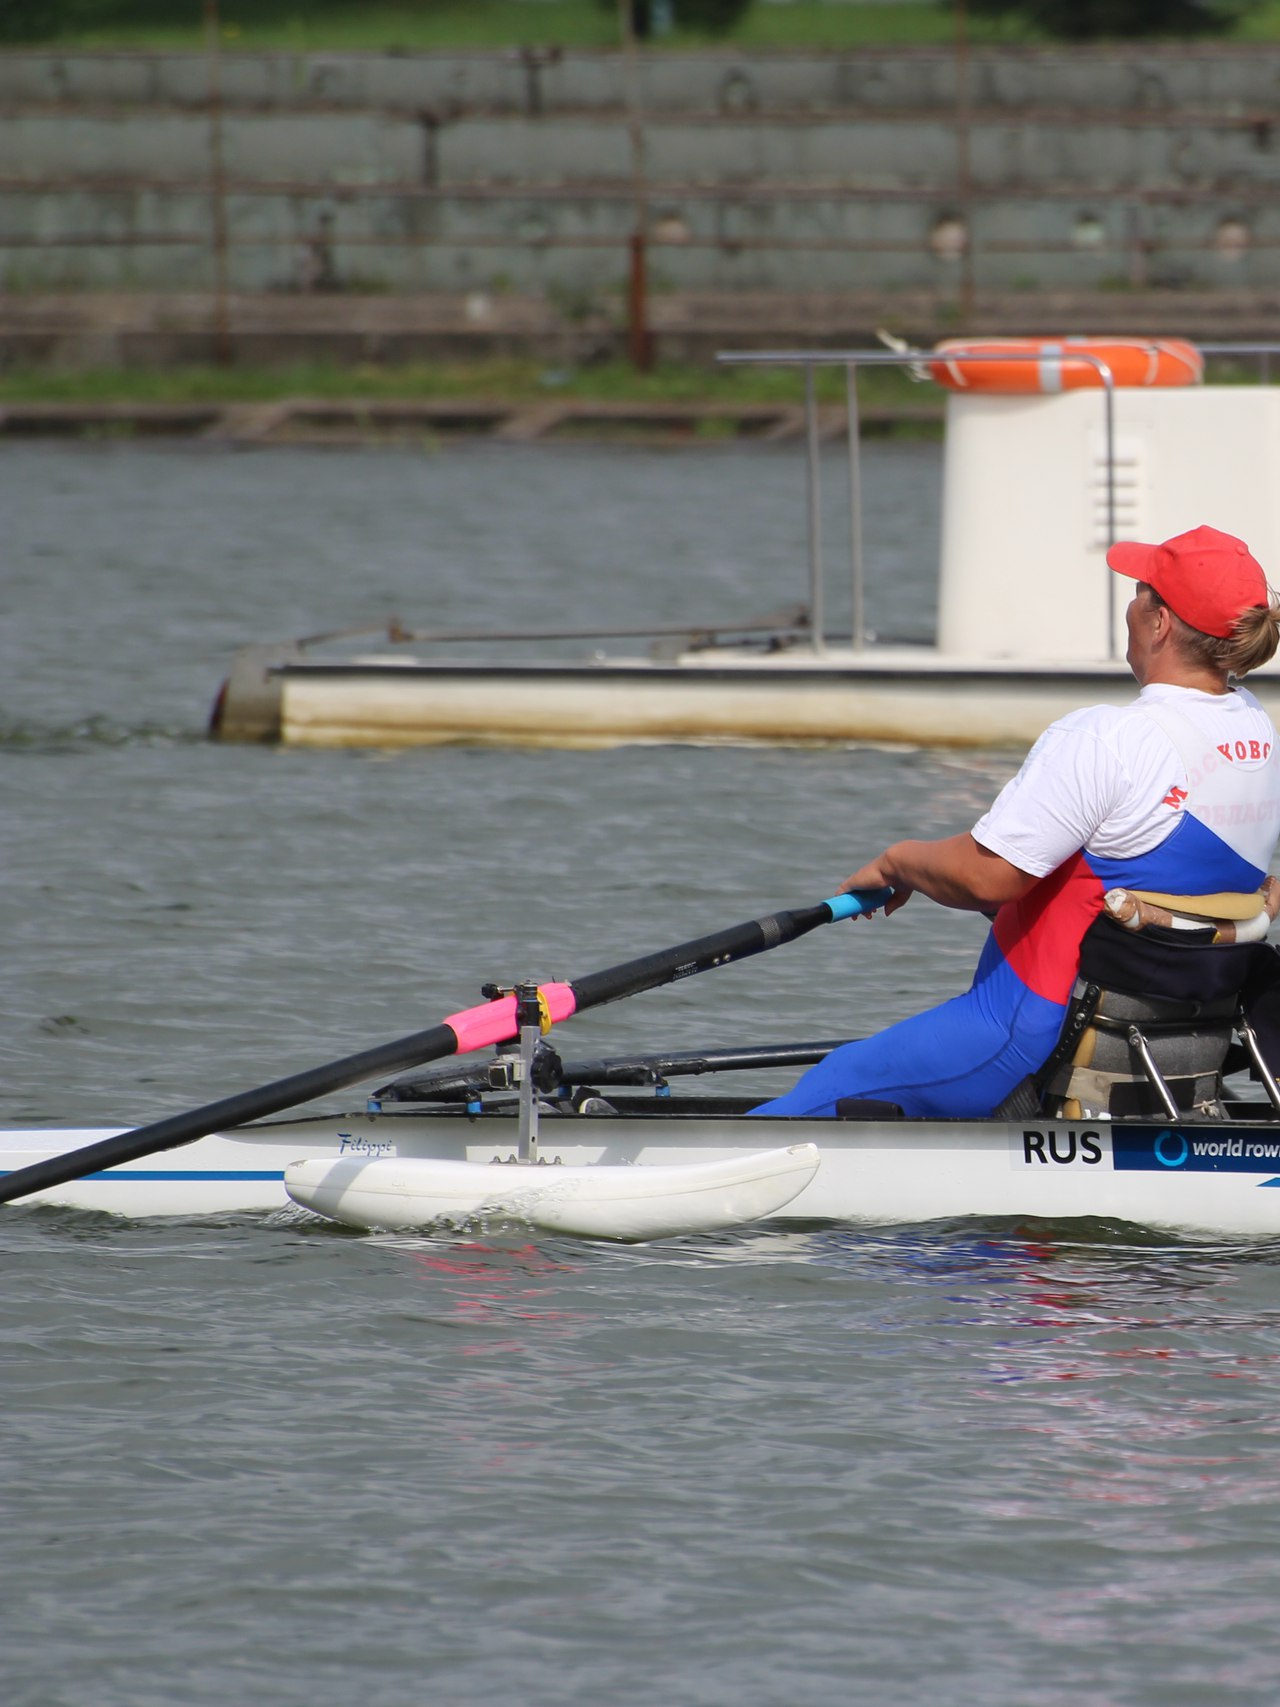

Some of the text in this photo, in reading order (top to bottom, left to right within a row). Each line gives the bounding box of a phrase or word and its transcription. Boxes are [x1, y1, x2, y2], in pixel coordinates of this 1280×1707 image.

[337, 1133, 392, 1157] Filippi
[1023, 1131, 1102, 1164] RUS
[1193, 1139, 1243, 1157] world
